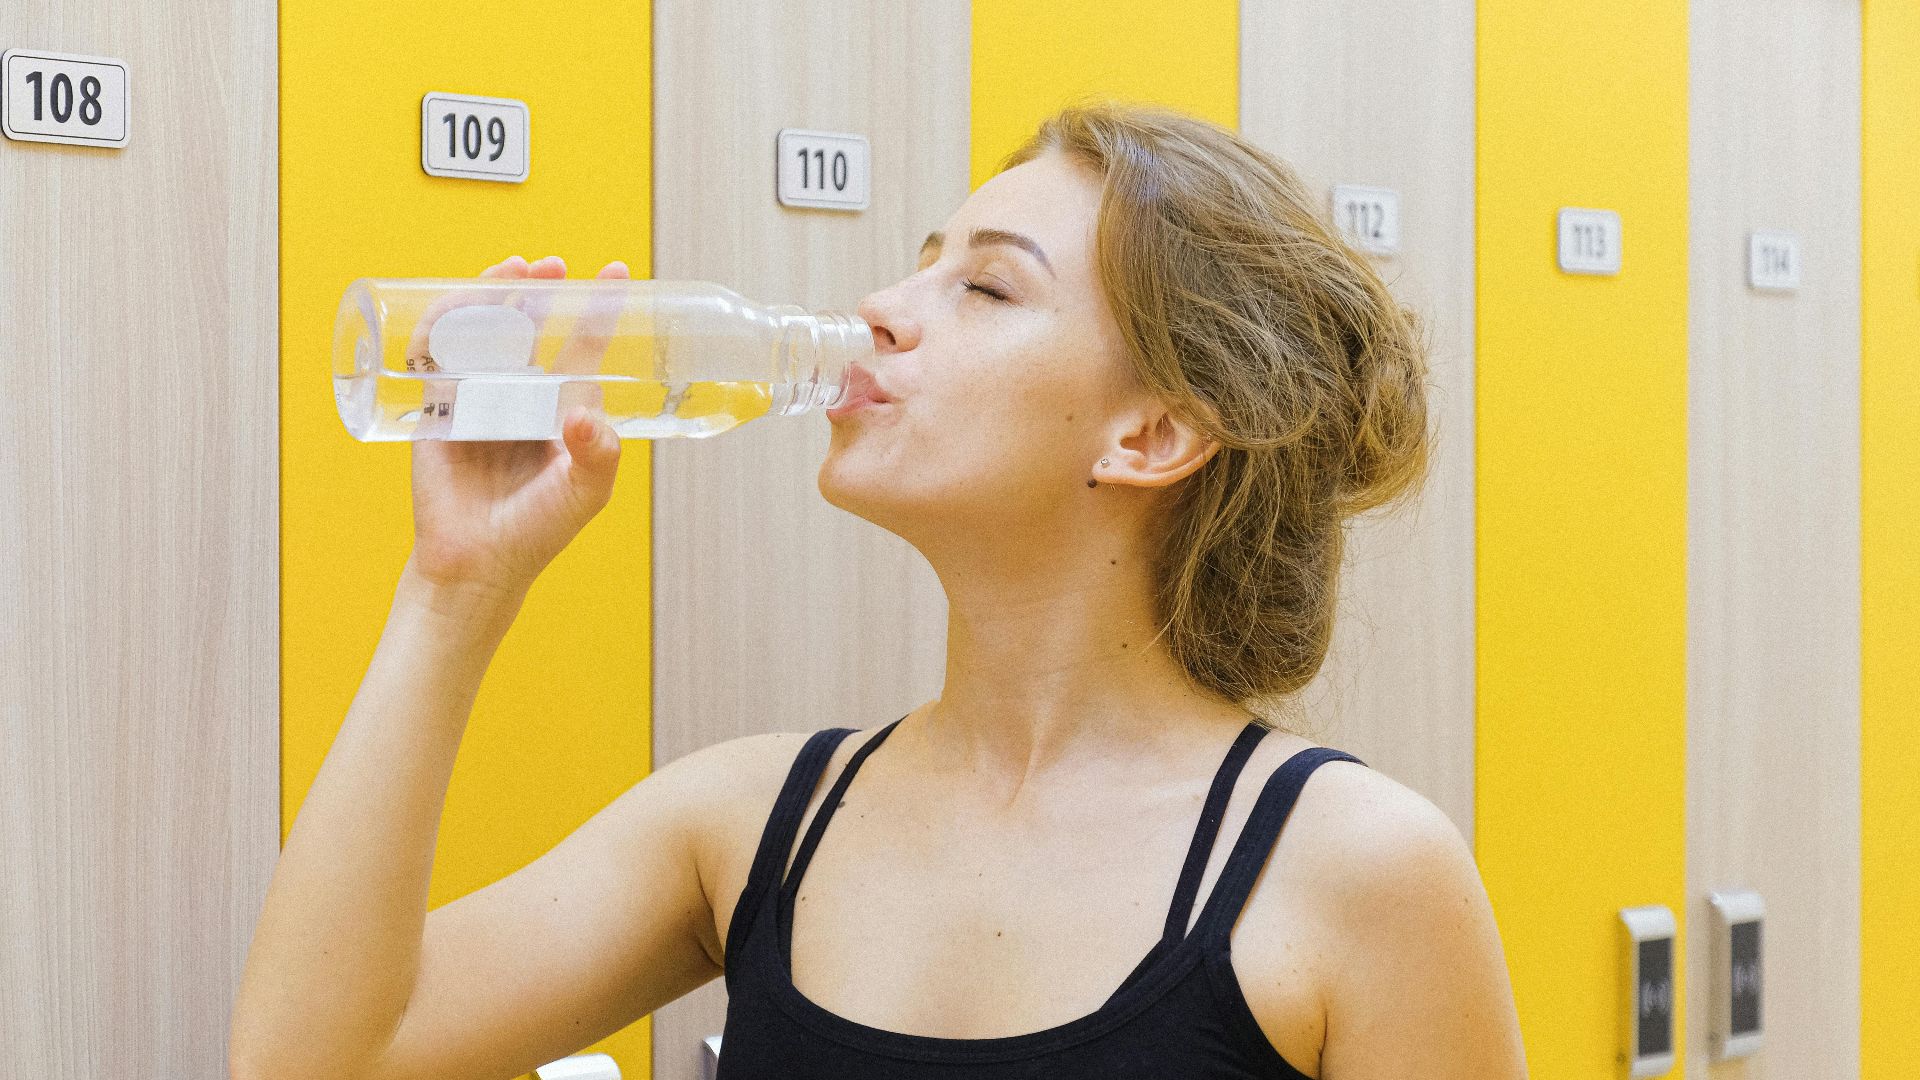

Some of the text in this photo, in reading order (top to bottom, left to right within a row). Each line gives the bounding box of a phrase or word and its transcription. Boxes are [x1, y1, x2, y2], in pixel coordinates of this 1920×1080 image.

[24, 71, 103, 127] 108
[442, 112, 506, 163] 109
[796, 147, 848, 192] 110
[1347, 202, 1385, 238] 112
[1572, 224, 1606, 258] 113
